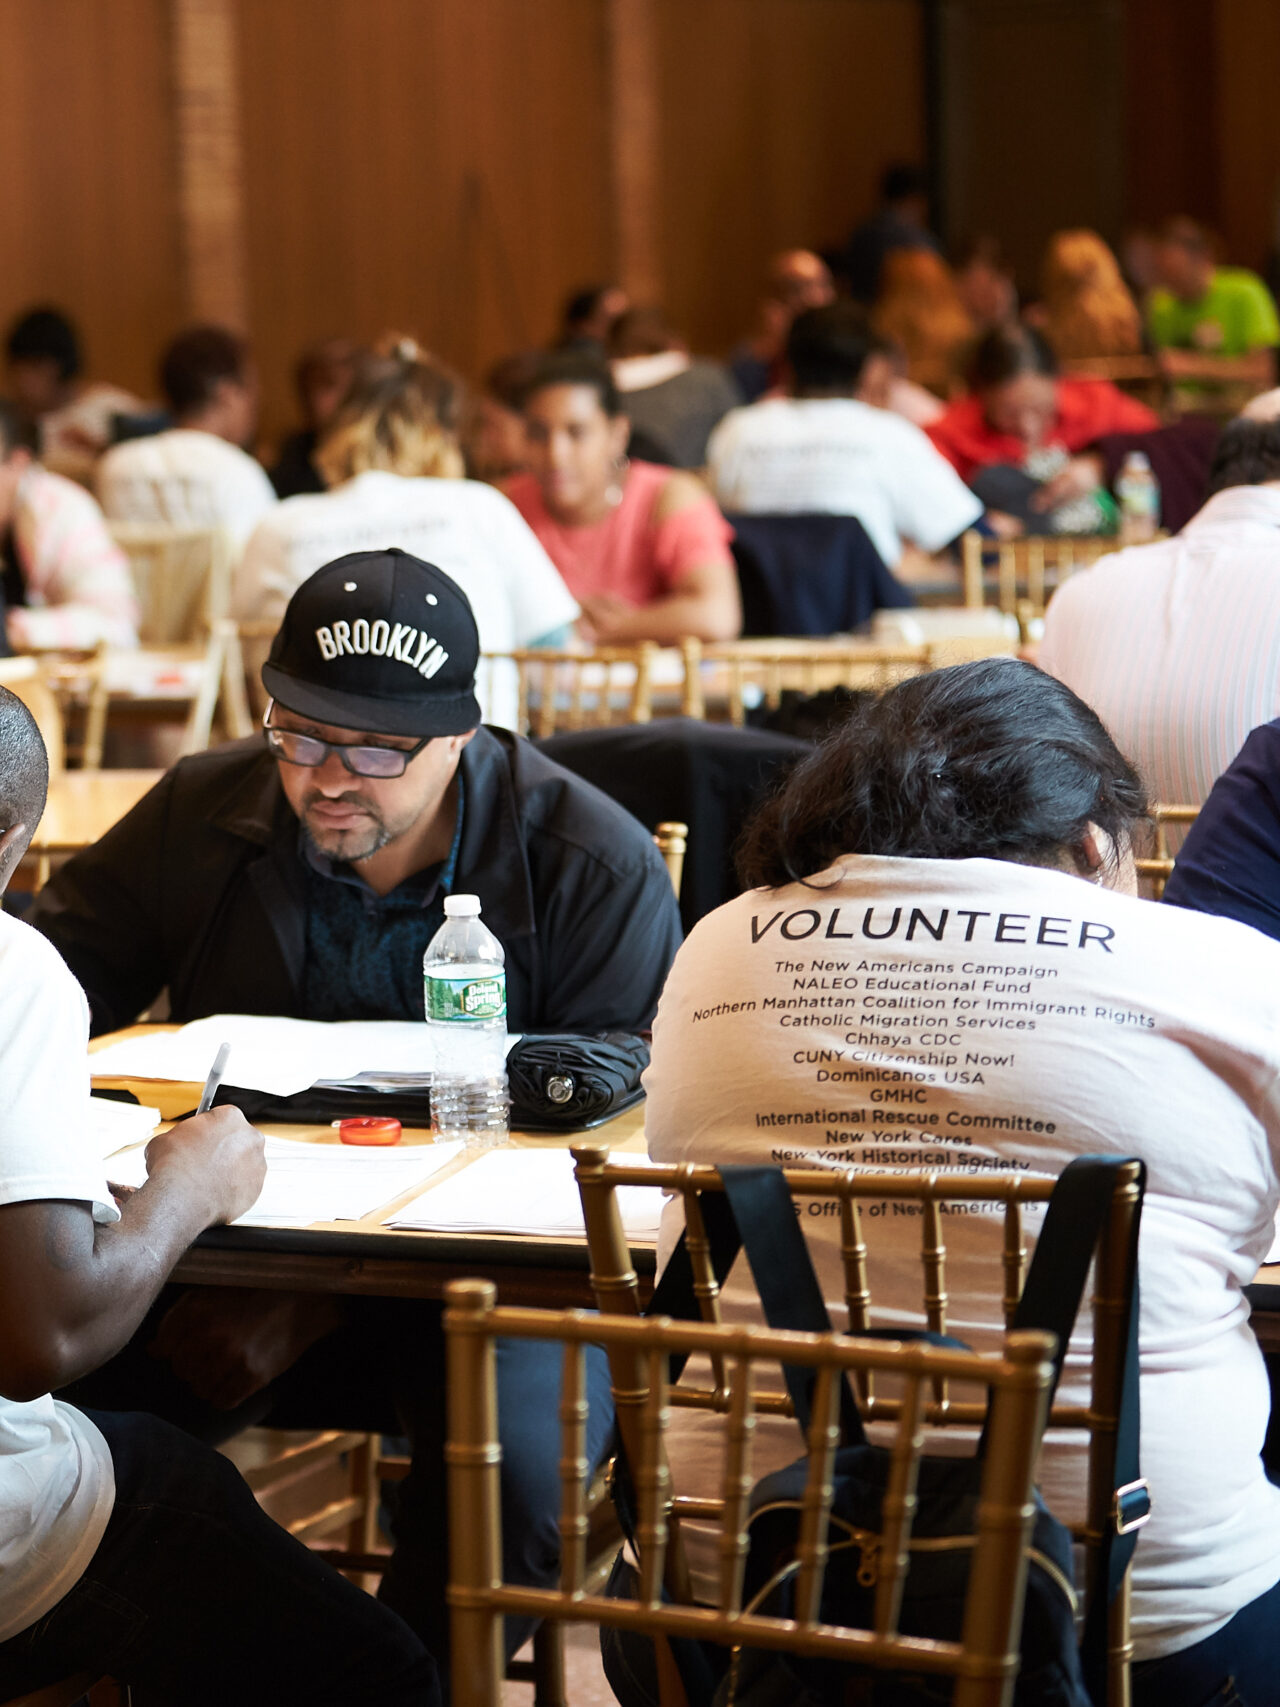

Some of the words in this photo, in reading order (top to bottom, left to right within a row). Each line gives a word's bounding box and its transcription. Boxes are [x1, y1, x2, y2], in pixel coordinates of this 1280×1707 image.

[316, 619, 449, 679] BROOKLYN
[751, 908, 1116, 953] VOLUNTEER
[775, 961, 805, 973] The
[811, 960, 850, 972] New
[856, 960, 955, 973] Americans
[962, 962, 1059, 979] Campaign
[793, 978, 858, 990] NALEO
[866, 978, 975, 992] Educational
[983, 980, 1031, 993] Fund
[465, 993, 501, 1011] Spring
[692, 1000, 756, 1022] Northern
[762, 996, 855, 1010] Manhattan
[863, 996, 945, 1009] Coalition
[953, 997, 979, 1010] for
[987, 999, 1087, 1017] Immigrant
[1095, 1007, 1156, 1028] Rights
[780, 1014, 853, 1027] Catholic
[860, 1014, 948, 1028] Migration
[956, 1016, 1036, 1030] Services
[845, 1032, 911, 1048] Chhaya
[920, 1033, 962, 1046] CDC
[793, 1050, 845, 1064] CUNY
[852, 1050, 957, 1067] Citizenship
[965, 1053, 1014, 1067] Now!
[817, 1068, 936, 1082] Dominicanos
[945, 1071, 985, 1085] USA
[870, 1089, 927, 1103] GMHC
[756, 1109, 865, 1127] International
[872, 1109, 939, 1125] Rescue
[947, 1111, 1056, 1134] Committee
[826, 1130, 864, 1144] New
[872, 1130, 911, 1143] York
[771, 1149, 855, 1163] New-York
[862, 1150, 950, 1164] Historical
[869, 1202, 886, 1216] of
